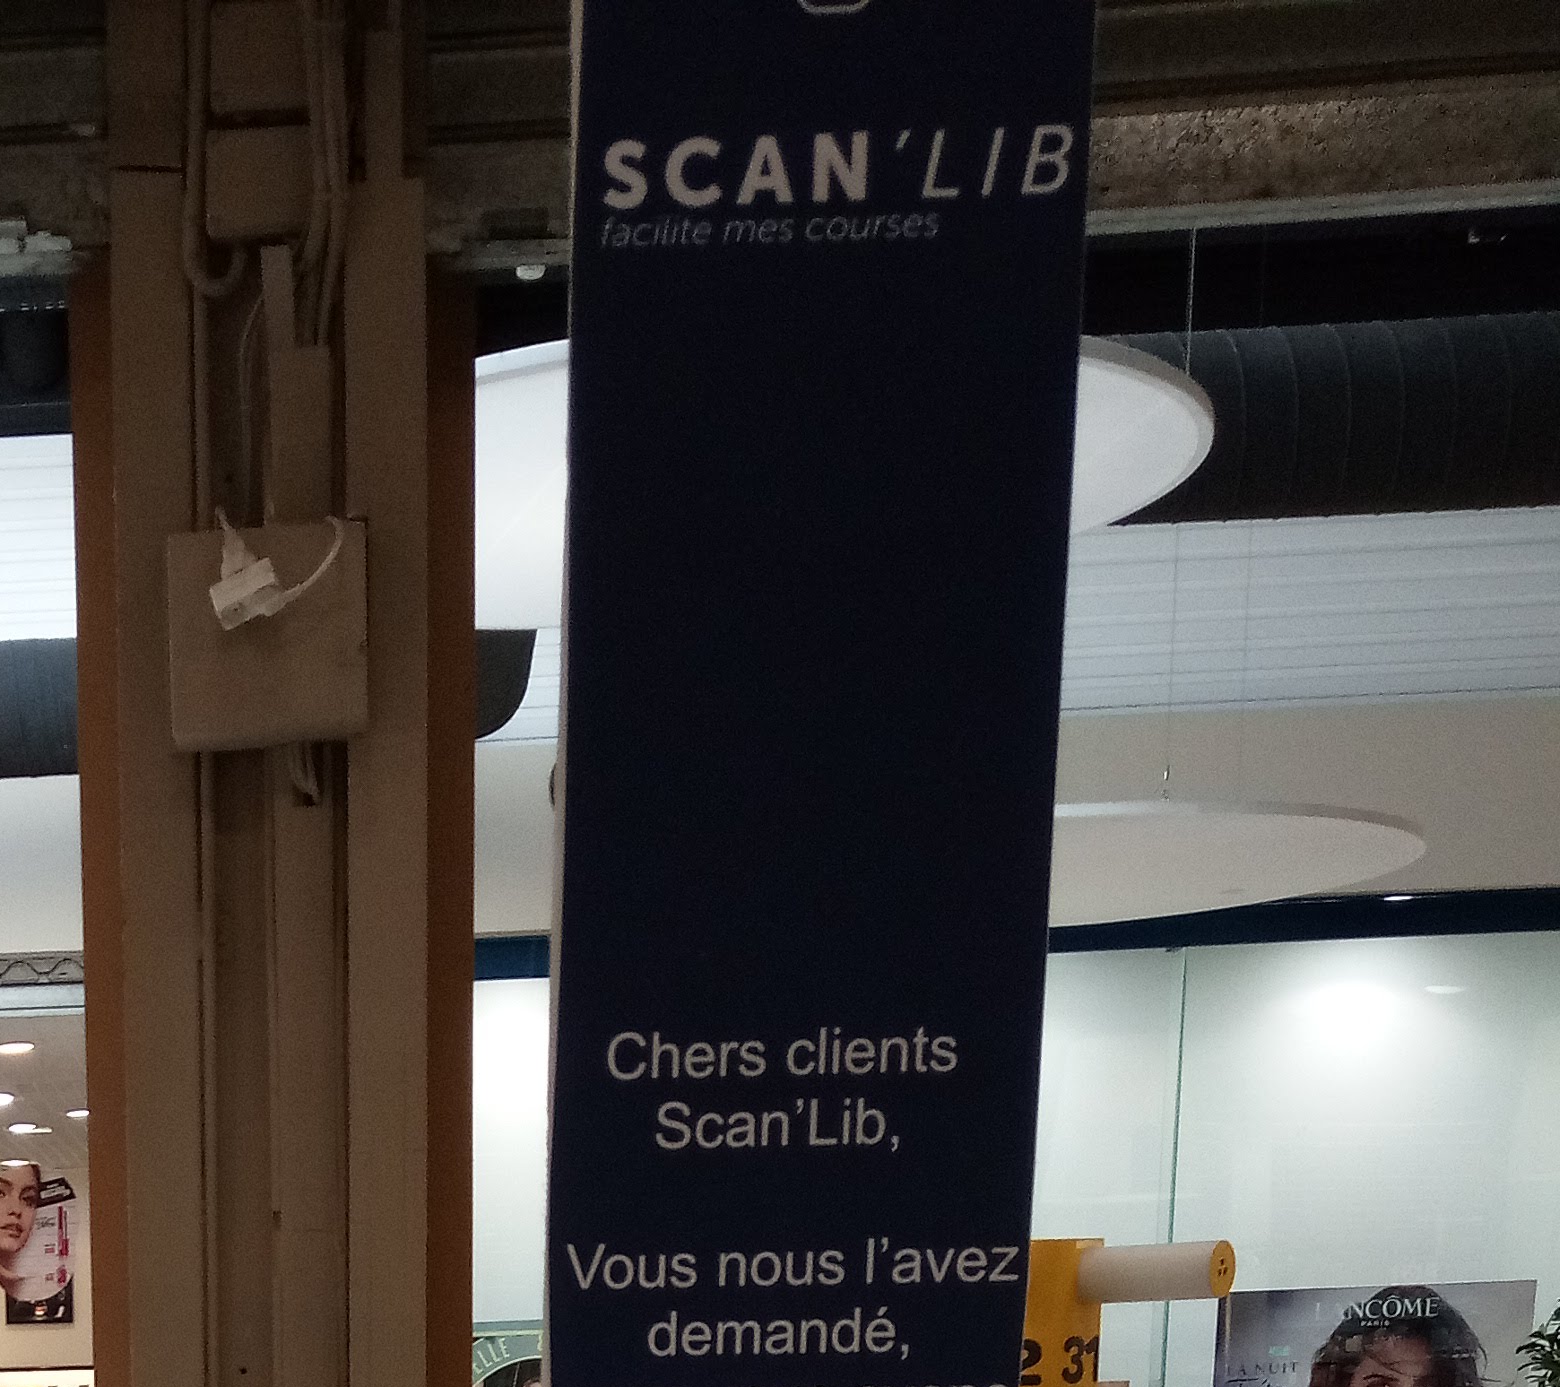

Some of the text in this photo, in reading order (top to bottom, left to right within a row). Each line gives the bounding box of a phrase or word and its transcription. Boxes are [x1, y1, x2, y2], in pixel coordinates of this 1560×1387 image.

[602, 123, 1075, 209] SCAN'LIB
[600, 211, 940, 248] facilite mes courses
[607, 1026, 959, 1081] Chers clients
[654, 1097, 901, 1153] Scan'Lib,
[566, 1236, 1020, 1291] Vous nous l'avez
[646, 1306, 911, 1360] demandé,
[1061, 1334, 1099, 1385] 31
